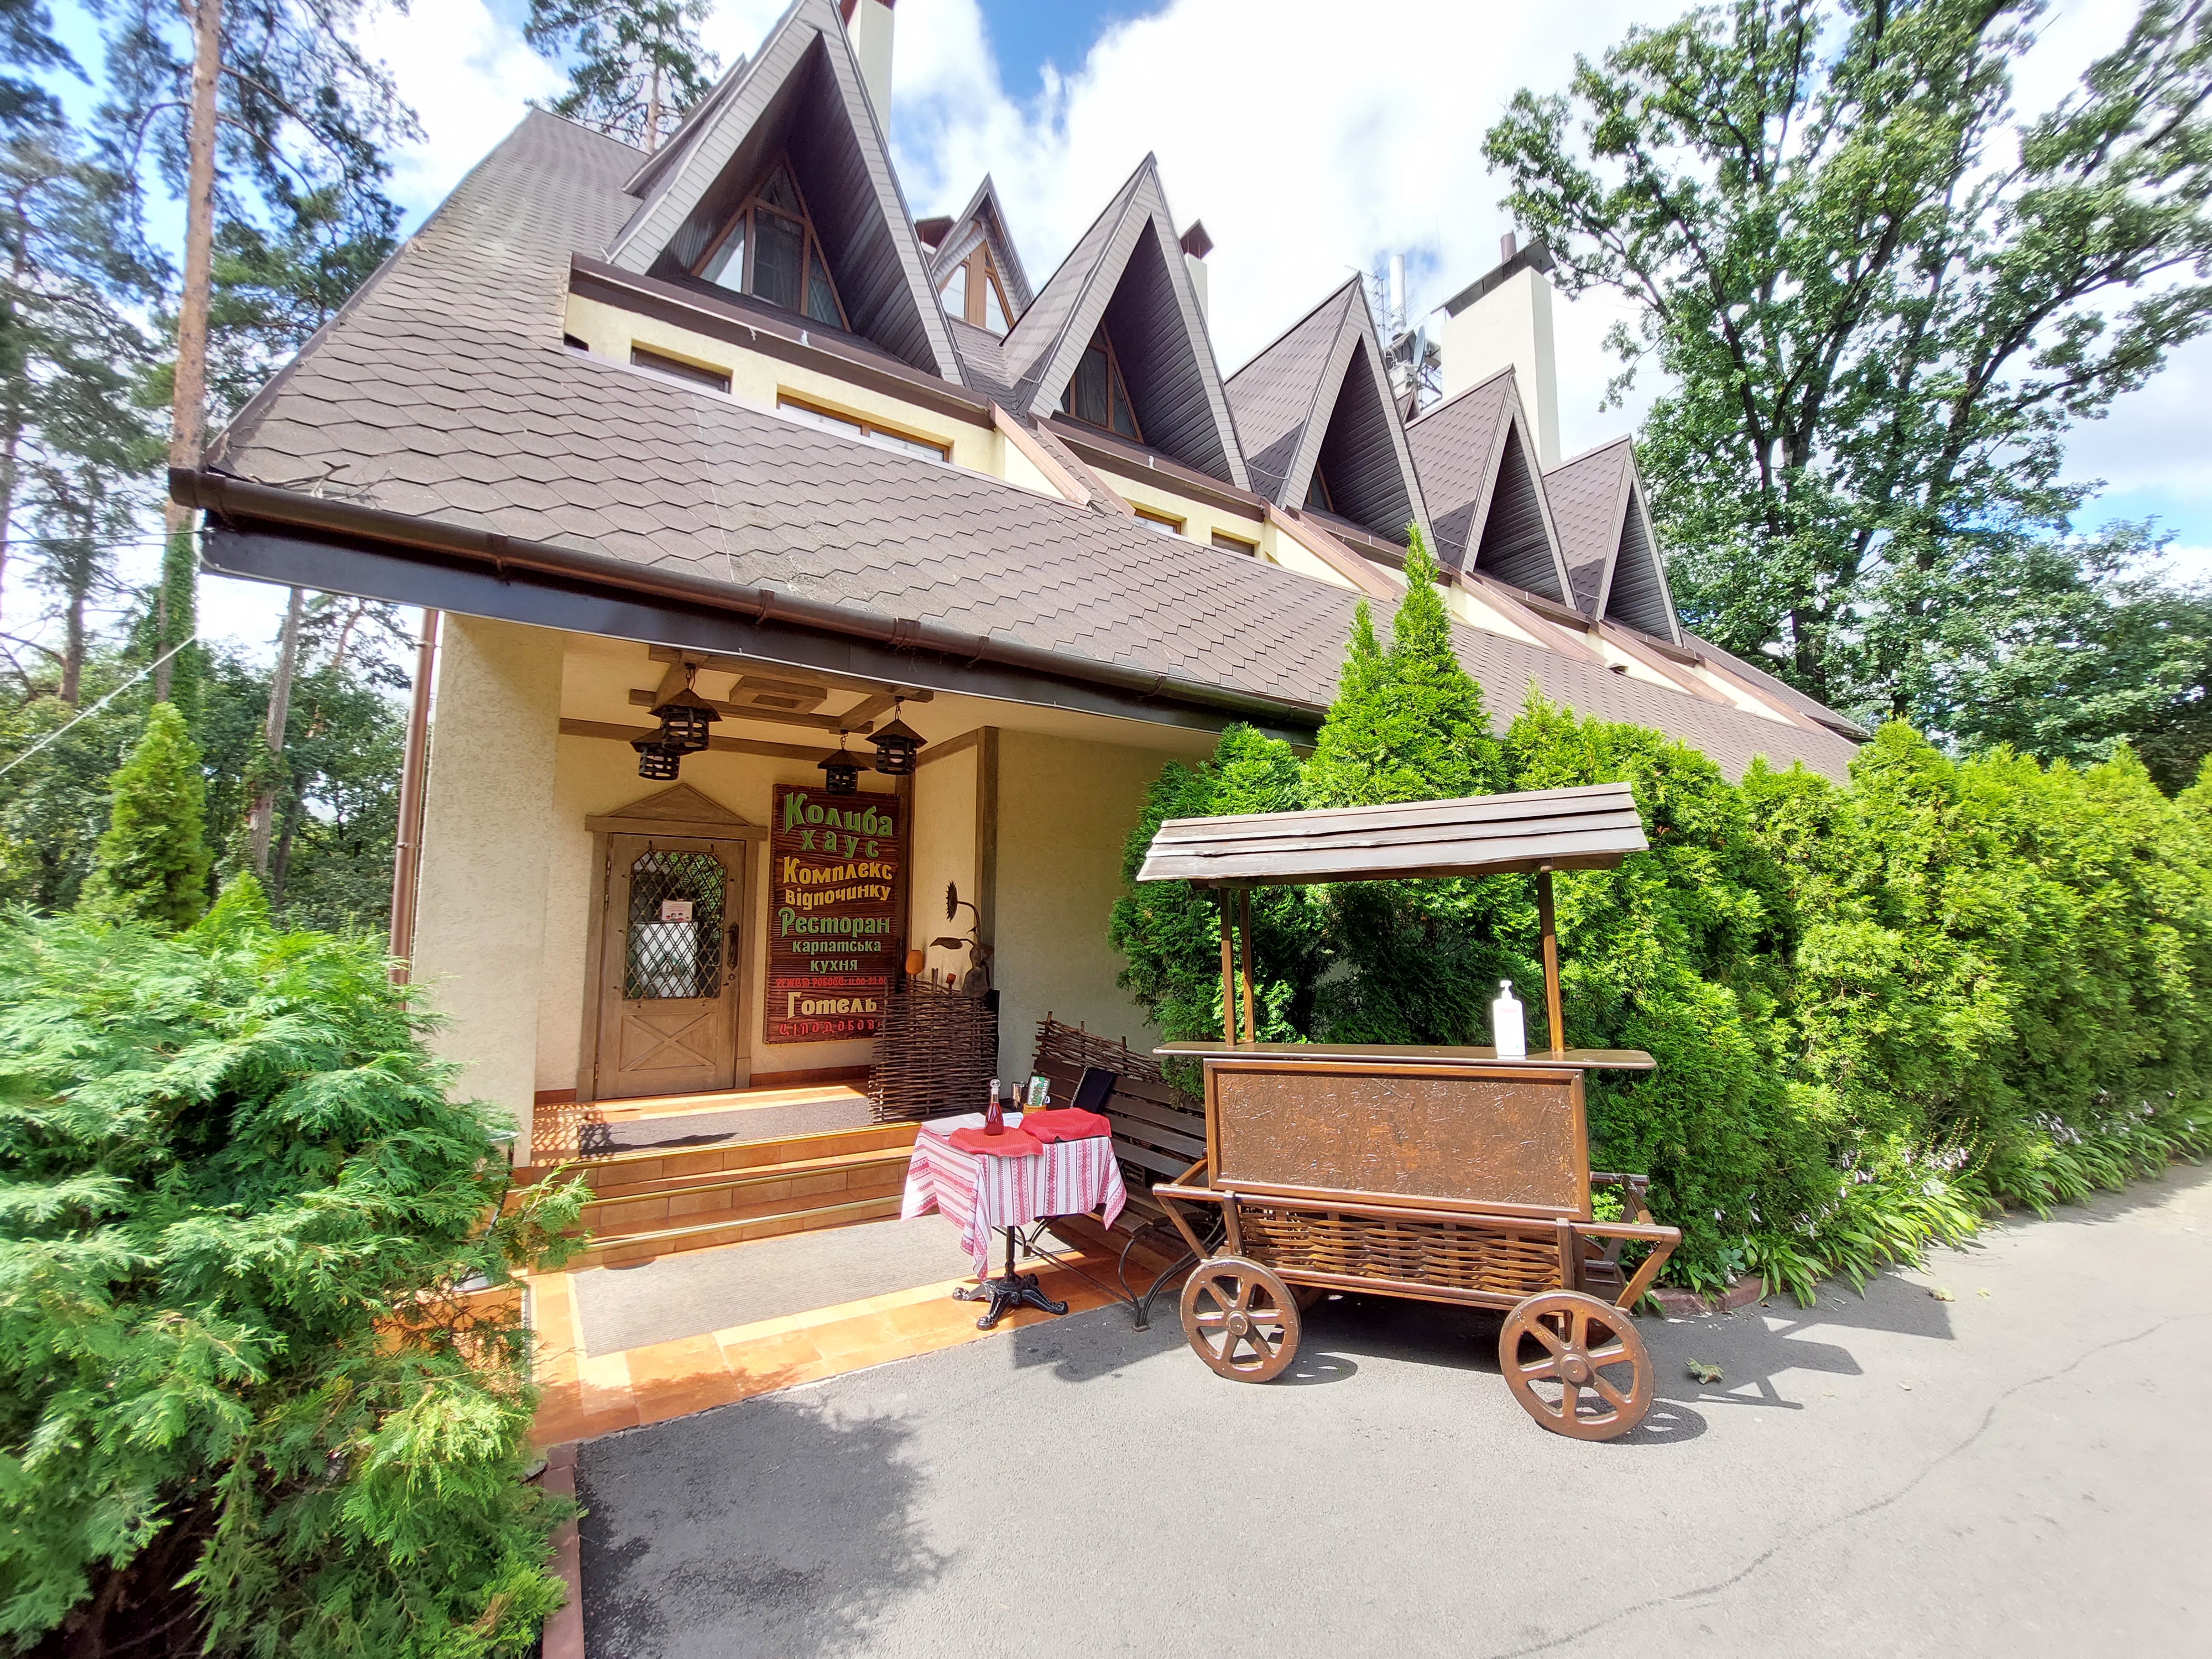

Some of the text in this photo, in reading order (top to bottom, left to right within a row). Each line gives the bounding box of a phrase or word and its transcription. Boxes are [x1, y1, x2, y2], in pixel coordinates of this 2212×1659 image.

[784, 792, 893, 837] Колиба
[800, 830, 879, 858] хаус
[783, 856, 893, 884] Комплекс
[785, 884, 891, 910] відпочинку
[778, 907, 890, 938] Ресторан
[792, 940, 881, 955] карпатська
[810, 959, 858, 974] кухня
[787, 992, 878, 1020] Готель
